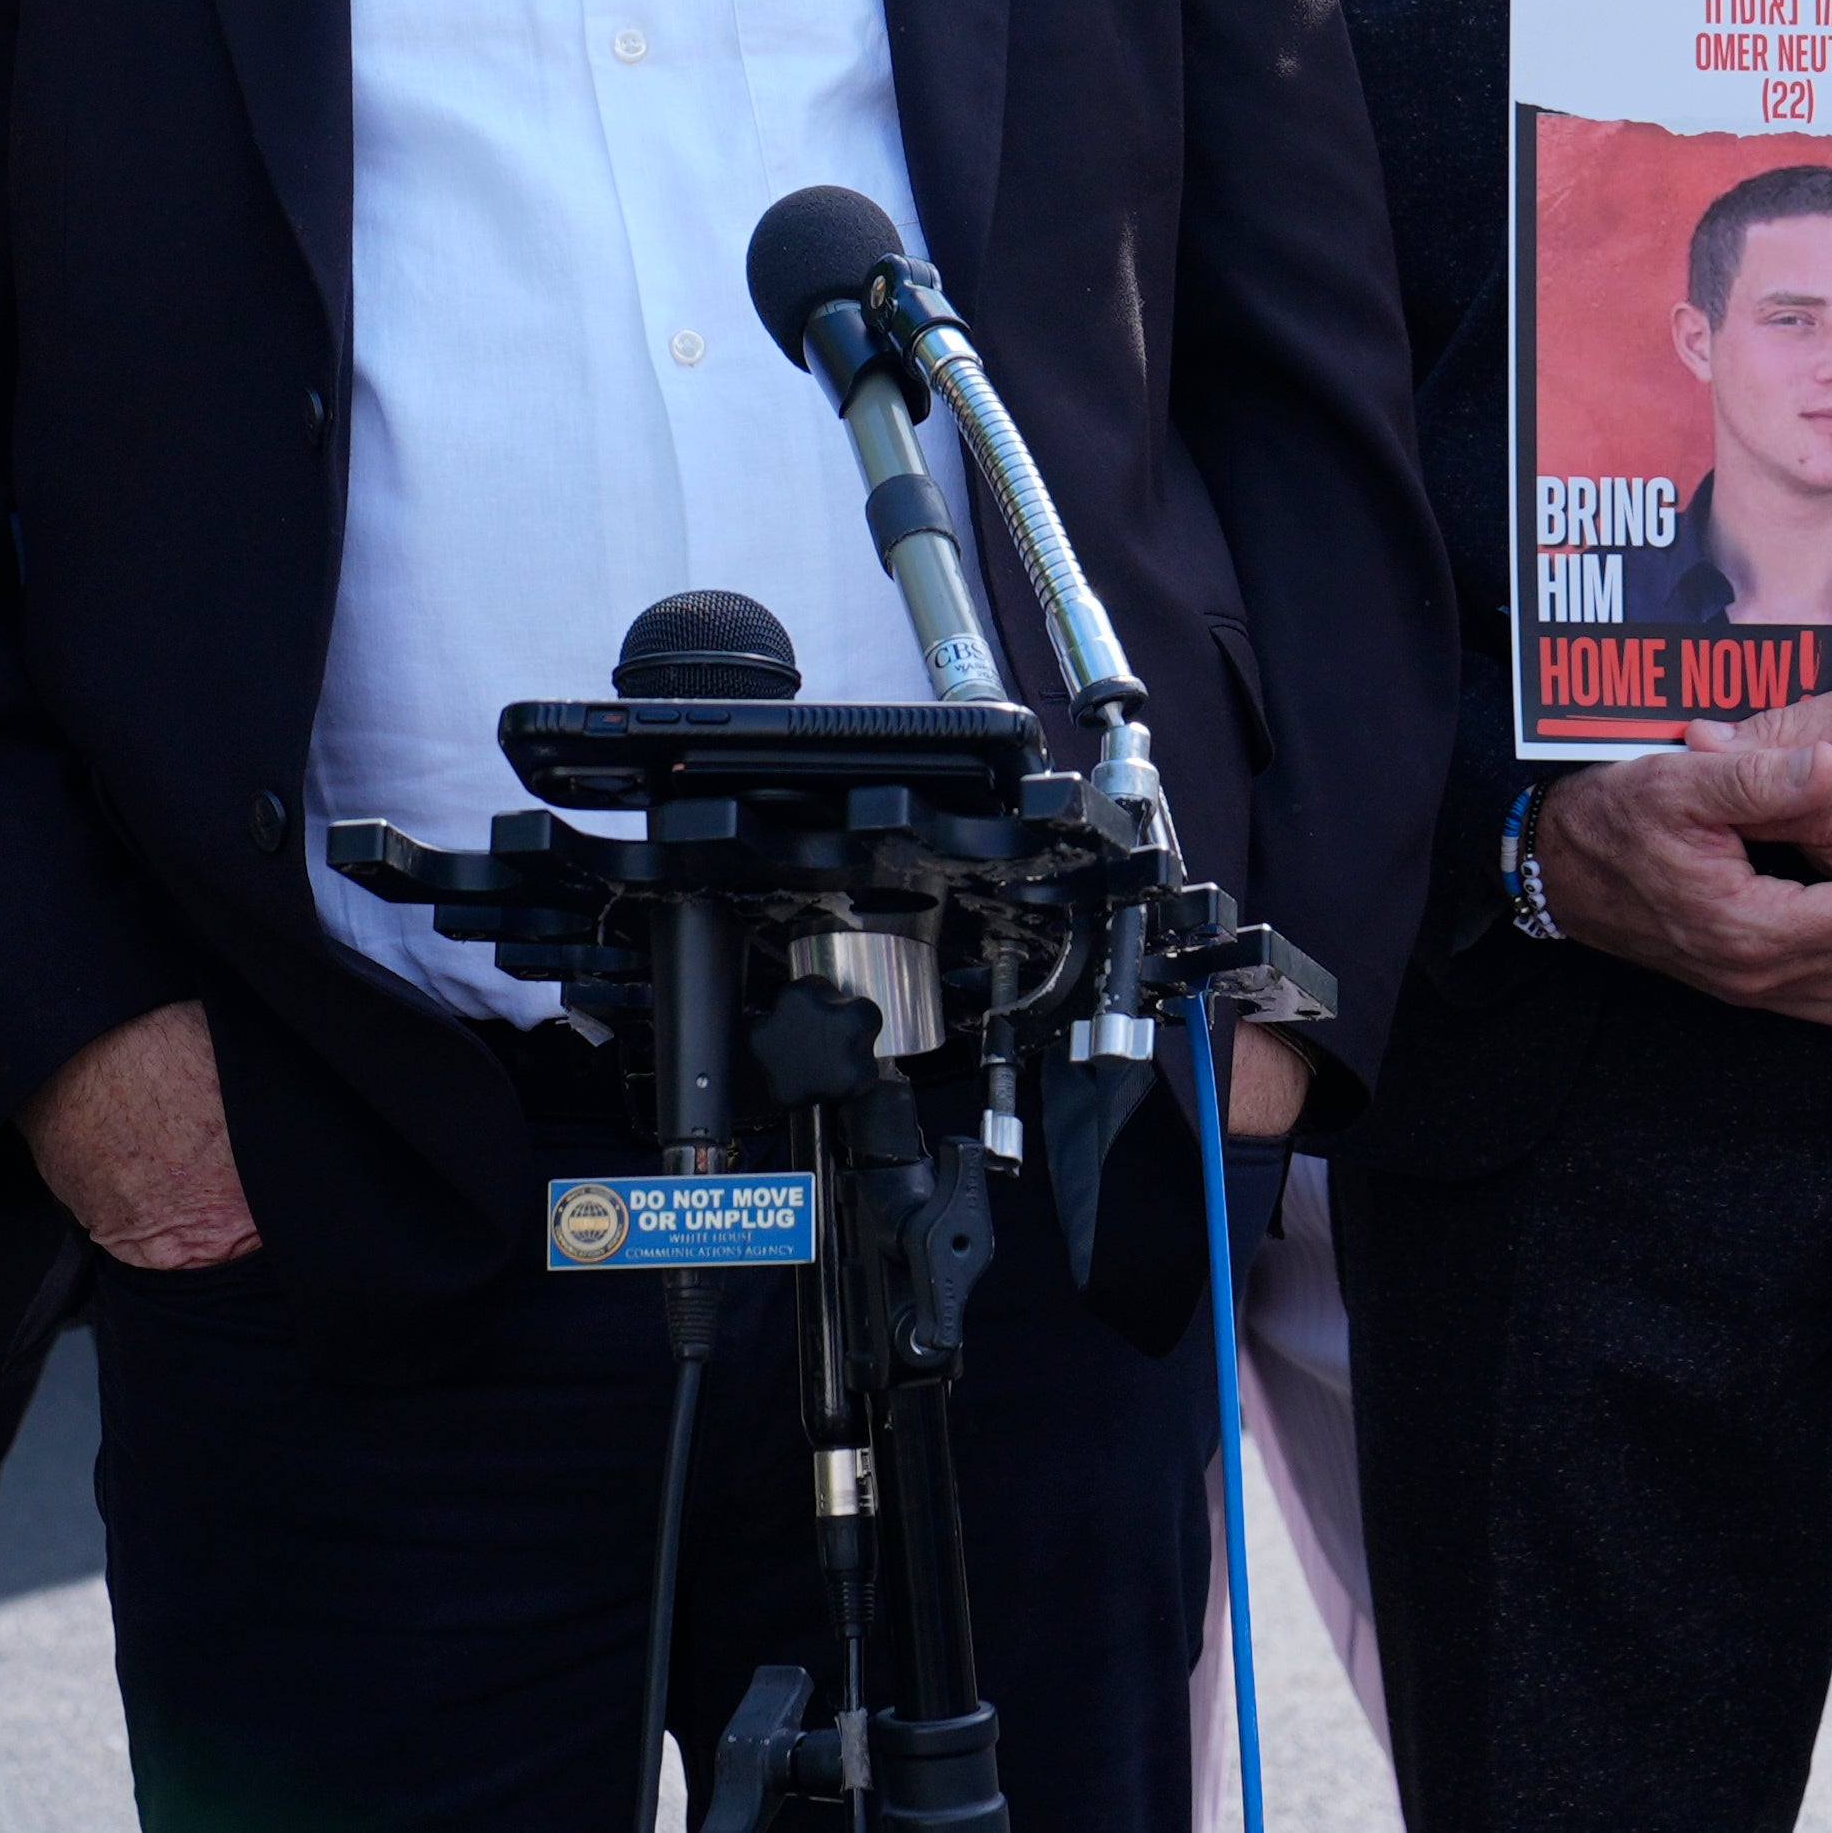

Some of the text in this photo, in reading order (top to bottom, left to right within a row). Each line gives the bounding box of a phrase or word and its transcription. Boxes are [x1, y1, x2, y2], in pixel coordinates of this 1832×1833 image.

[1695, 32, 1769, 71] OMER
[1762, 78, 1815, 124] (22)
[1536, 475, 1676, 548] BRING
[1537, 553, 1624, 623] HIM
[935, 642, 985, 668] CBS
[1539, 630, 1823, 709] HOME NOW!
[630, 1186, 805, 1210] DO NOT MOVE
[638, 1208, 796, 1231] OR UNPLUG
[669, 1233, 708, 1243] WHITE
